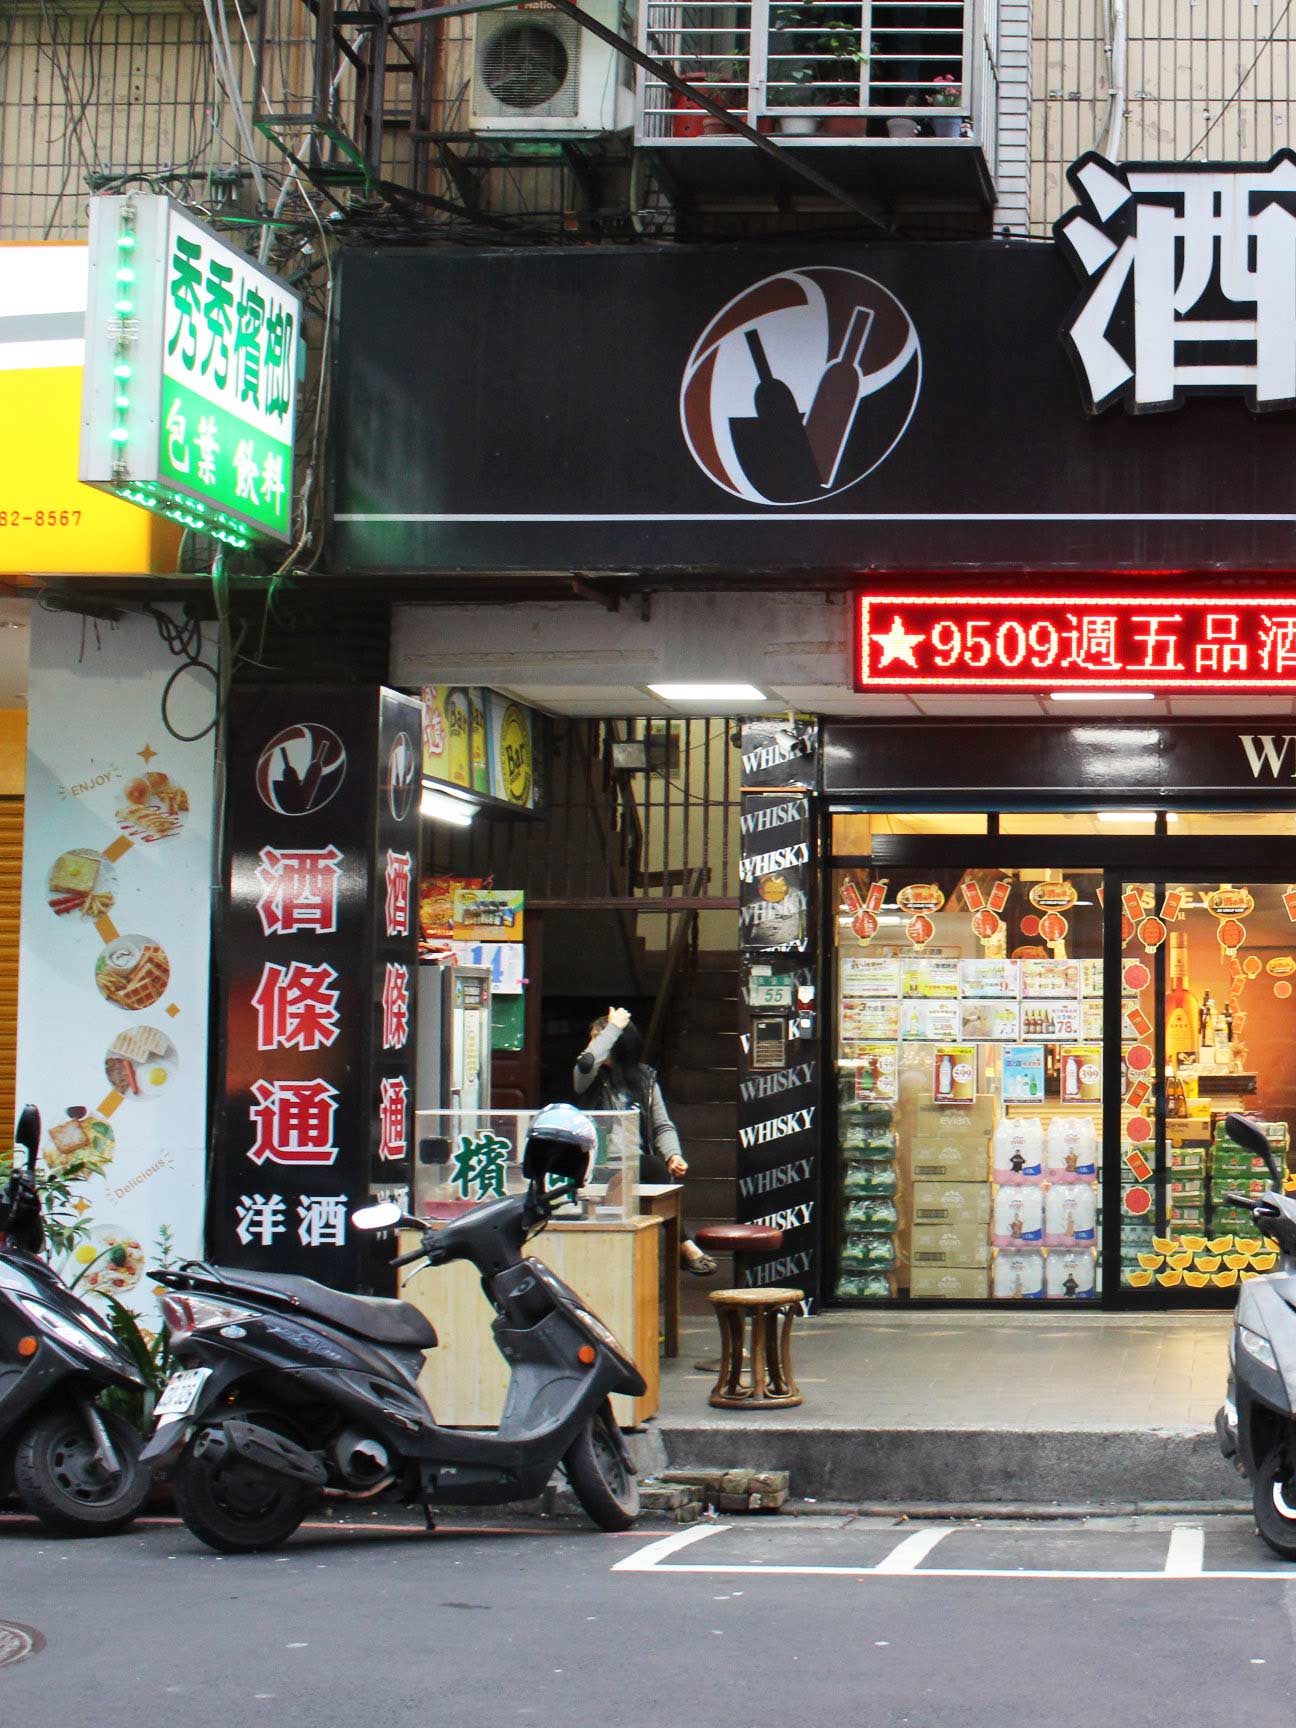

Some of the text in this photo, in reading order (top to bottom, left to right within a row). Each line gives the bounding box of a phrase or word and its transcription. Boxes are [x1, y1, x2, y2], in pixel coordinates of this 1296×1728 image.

[168, 235, 294, 424] 秀秀檳榔
[165, 399, 285, 515] 包葉 飲料
[70, 772, 113, 797] ENJOY
[740, 799, 810, 835] WHISKY
[739, 842, 810, 882] WHISKY
[247, 845, 345, 1165] 酒條通
[764, 989, 783, 1002] 55
[740, 1061, 816, 1102] WHISKY
[739, 1106, 816, 1149] WHISKY
[113, 1158, 166, 1200] Delicious
[739, 1157, 815, 1198] WHISKY
[236, 1194, 347, 1246] 洋酒
[744, 1201, 815, 1233] ISKY
